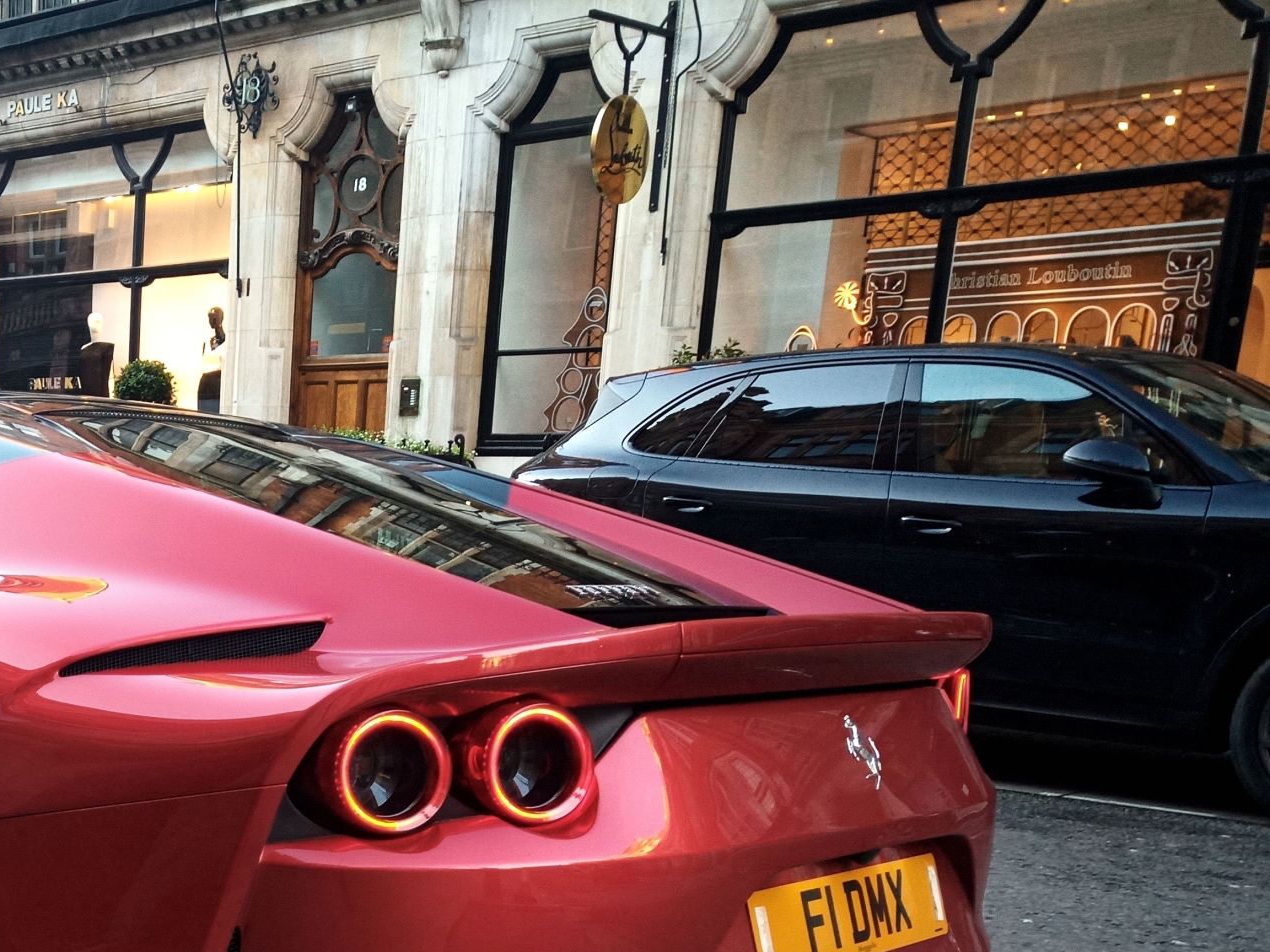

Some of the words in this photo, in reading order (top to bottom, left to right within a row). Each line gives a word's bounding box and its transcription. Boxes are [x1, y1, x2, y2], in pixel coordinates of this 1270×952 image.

[7, 92, 53, 118] PAULE
[57, 88, 79, 109] KA
[353, 176, 367, 192] 18
[949, 268, 1022, 290] hristian
[1026, 261, 1133, 286] Louboutin
[64, 376, 82, 390] KA
[842, 868, 912, 944] DMX
